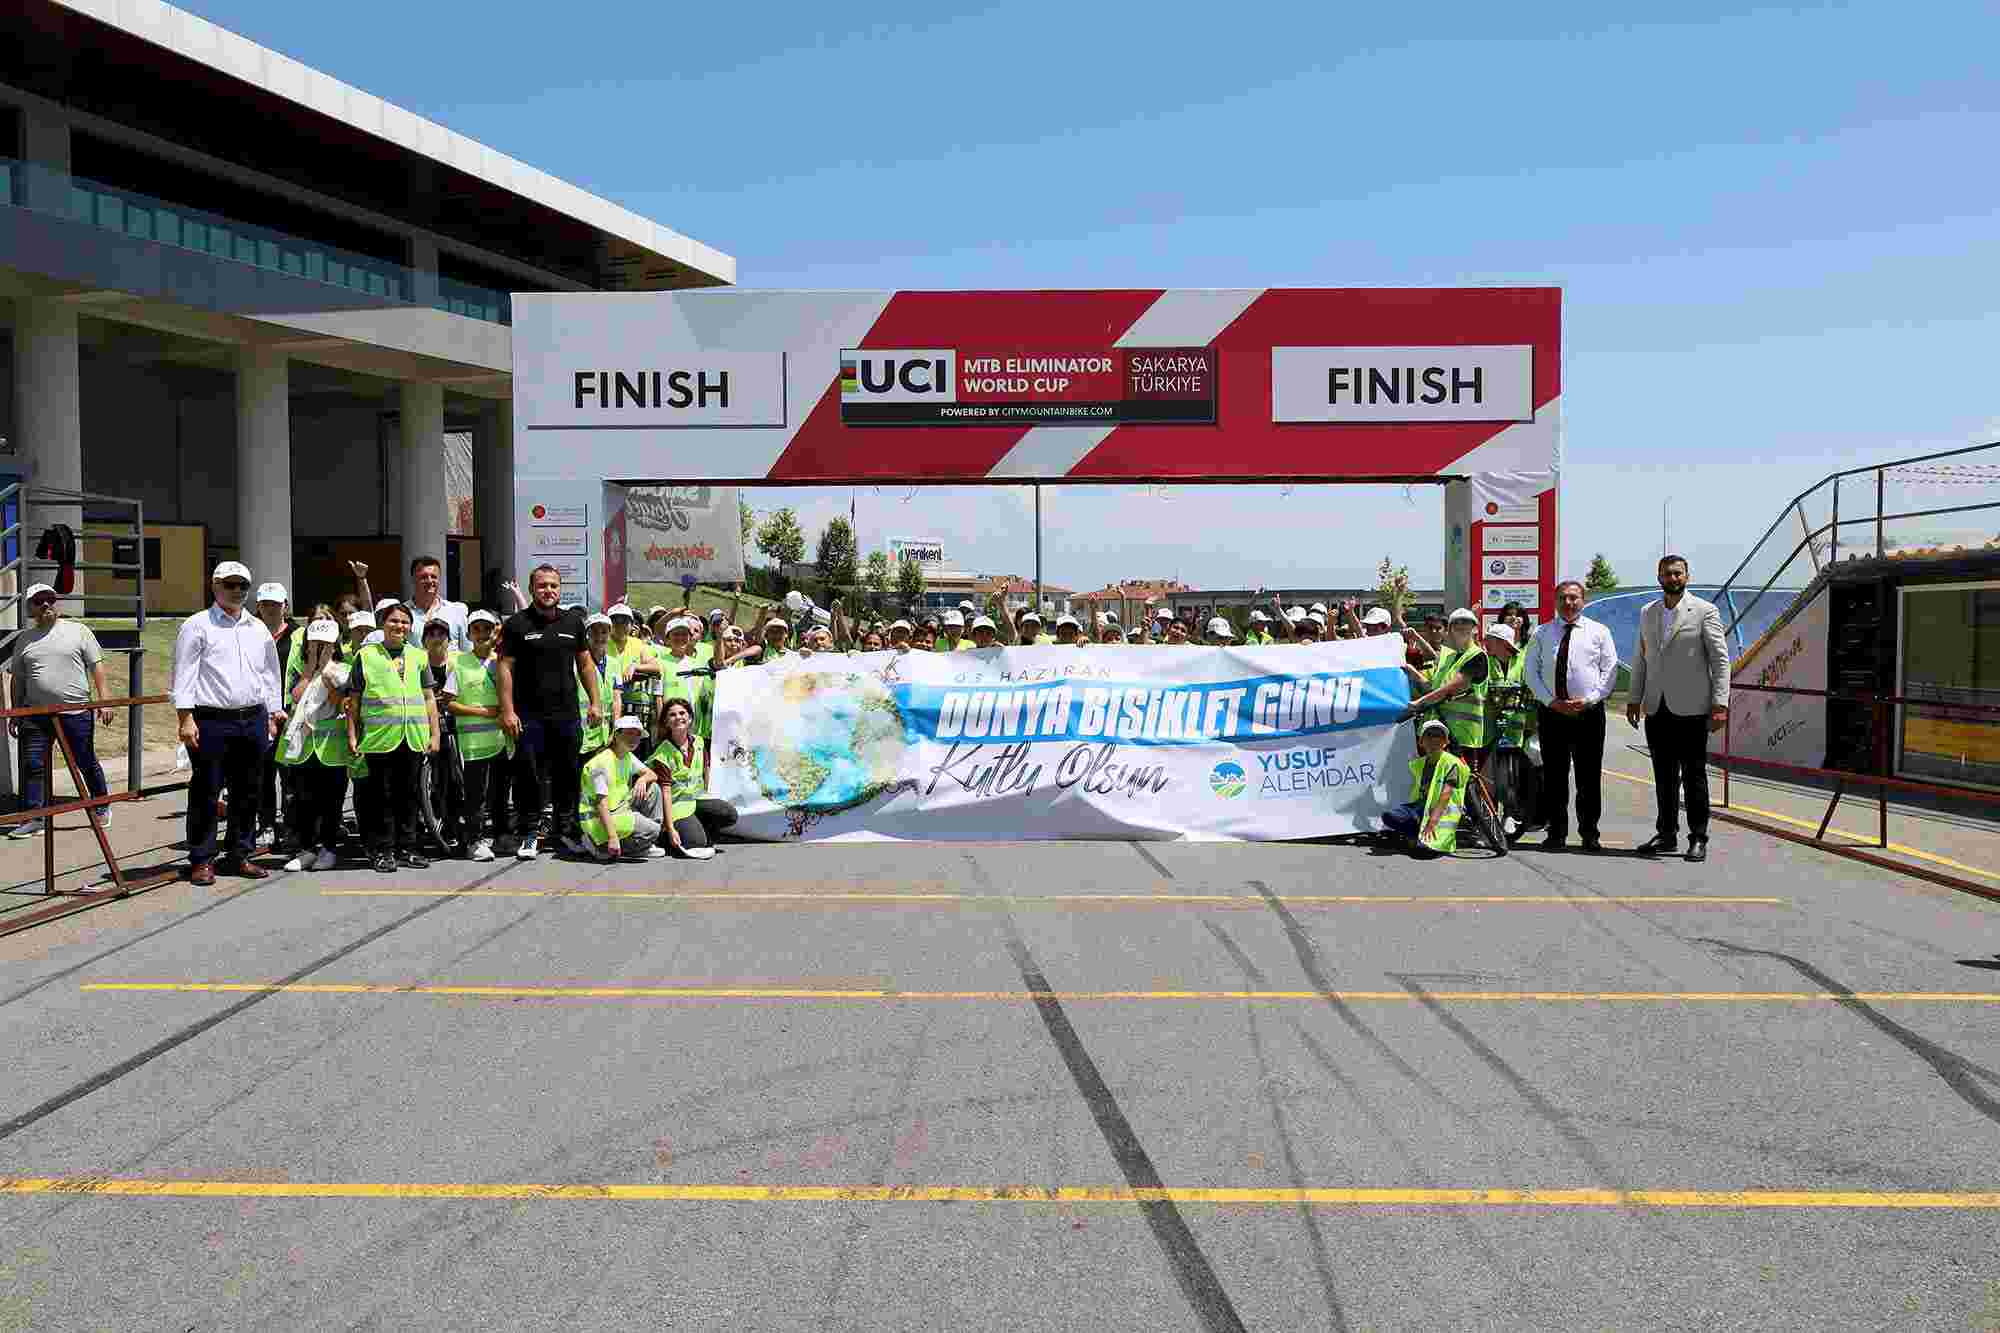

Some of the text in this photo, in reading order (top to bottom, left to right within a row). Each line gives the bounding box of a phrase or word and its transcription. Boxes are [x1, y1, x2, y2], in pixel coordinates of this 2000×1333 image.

[861, 359, 946, 394] UCI
[964, 358, 1113, 373] MTB ELIMINATOR
[1131, 356, 1208, 373] SAKARYA
[575, 371, 729, 409] FINISH
[964, 378, 1070, 393] WORLD CUP
[1328, 367, 1483, 405] FINISH
[941, 407, 1113, 417] POWERED BY CITYMOUNTAINBIKE.COM
[925, 740, 1169, 798] Kutlu Olsun
[1256, 747, 1337, 772] YUSUF
[1260, 763, 1377, 793] ALEMDAR
